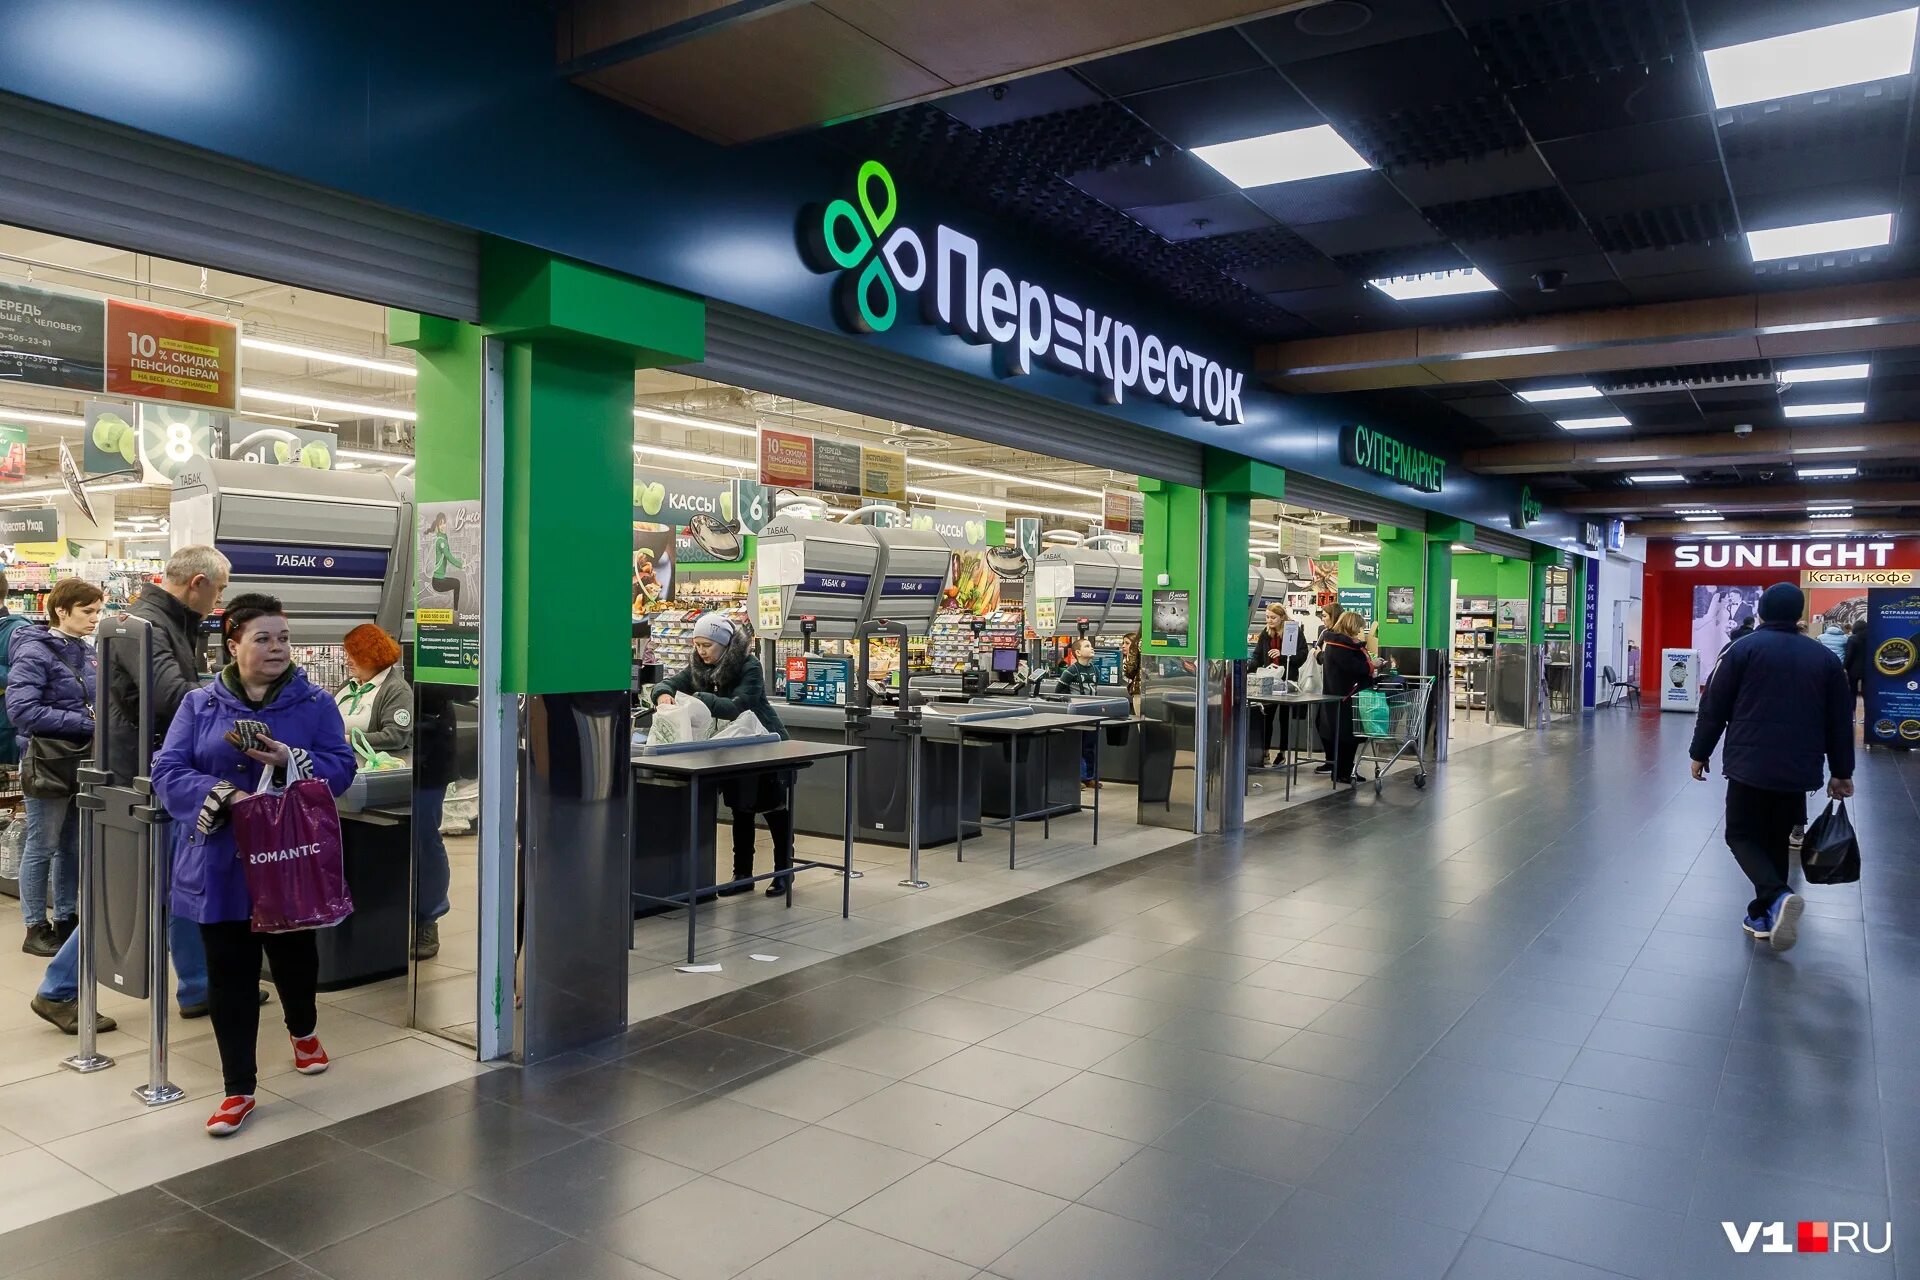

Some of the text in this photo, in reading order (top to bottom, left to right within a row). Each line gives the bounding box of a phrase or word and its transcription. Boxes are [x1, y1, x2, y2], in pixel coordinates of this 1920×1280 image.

[34, 317, 82, 333] ЧЕЛОВЕК?
[937, 224, 1245, 424] Перекресток
[127, 331, 157, 358] 10
[171, 352, 219, 369] СКИДКА
[131, 358, 219, 381] ПЕНСИОНЕРАМ
[165, 423, 193, 463] 8
[767, 437, 778, 454] 10
[1355, 425, 1446, 493] СУПЕРМАРКЕТ
[180, 472, 202, 486] ТАБАК
[669, 493, 716, 513] КАССЫ
[750, 495, 763, 520] 6
[27, 518, 44, 532] Уход
[885, 512, 893, 528] 5
[766, 525, 789, 535] ТАБАК
[935, 523, 964, 538] КАССЫ
[1028, 529, 1038, 549] 4
[275, 554, 317, 568] ТАБАК
[1674, 543, 1895, 568] SUNLIGHT
[821, 578, 839, 588] ТАБАК
[901, 582, 916, 591] ТАБАК
[1584, 583, 1596, 669] ХИМЧИСТКА
